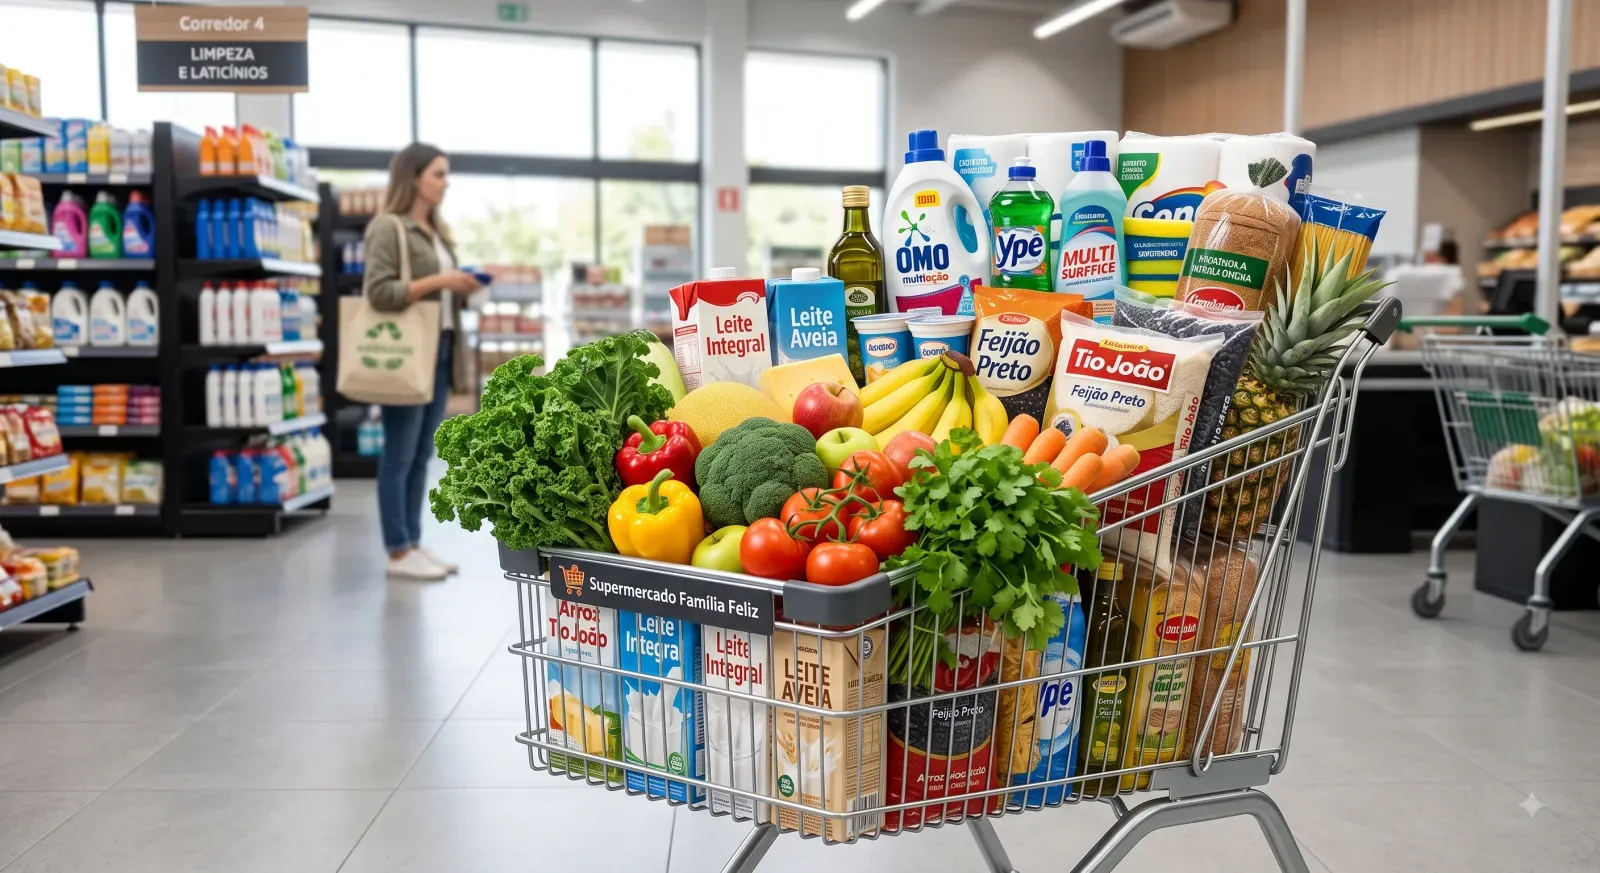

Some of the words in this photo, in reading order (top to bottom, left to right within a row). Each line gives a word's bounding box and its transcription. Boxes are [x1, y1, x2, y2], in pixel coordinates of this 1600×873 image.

[179, 15, 250, 31] Corredor
[253, 15, 265, 31] 4
[190, 47, 255, 61] LIMPEZA
[178, 66, 188, 79] E
[190, 63, 268, 79] LATICÍNIOS
[896, 243, 949, 274] OMO
[1062, 244, 1115, 267] MULTI
[1061, 261, 1116, 280] SURFFICE
[715, 314, 753, 334] Leite
[790, 305, 833, 327] Leite
[706, 333, 765, 358] Integral
[790, 326, 838, 349] Aveia
[977, 328, 1041, 359] Feijão
[975, 355, 1032, 381] Preto
[1074, 347, 1105, 371] Tio
[1106, 354, 1165, 381] João
[1071, 384, 1109, 403] Feijão
[1110, 390, 1146, 408] Preto
[589, 576, 677, 605] Supermercado
[679, 592, 725, 613] Família
[728, 599, 759, 619] Feliz
[559, 600, 600, 623] Arroz
[638, 613, 675, 636] Leite
[716, 631, 749, 659] Leite
[706, 652, 763, 686] Integral
[784, 657, 831, 687] LEITE
[781, 680, 833, 710] AVEIA
